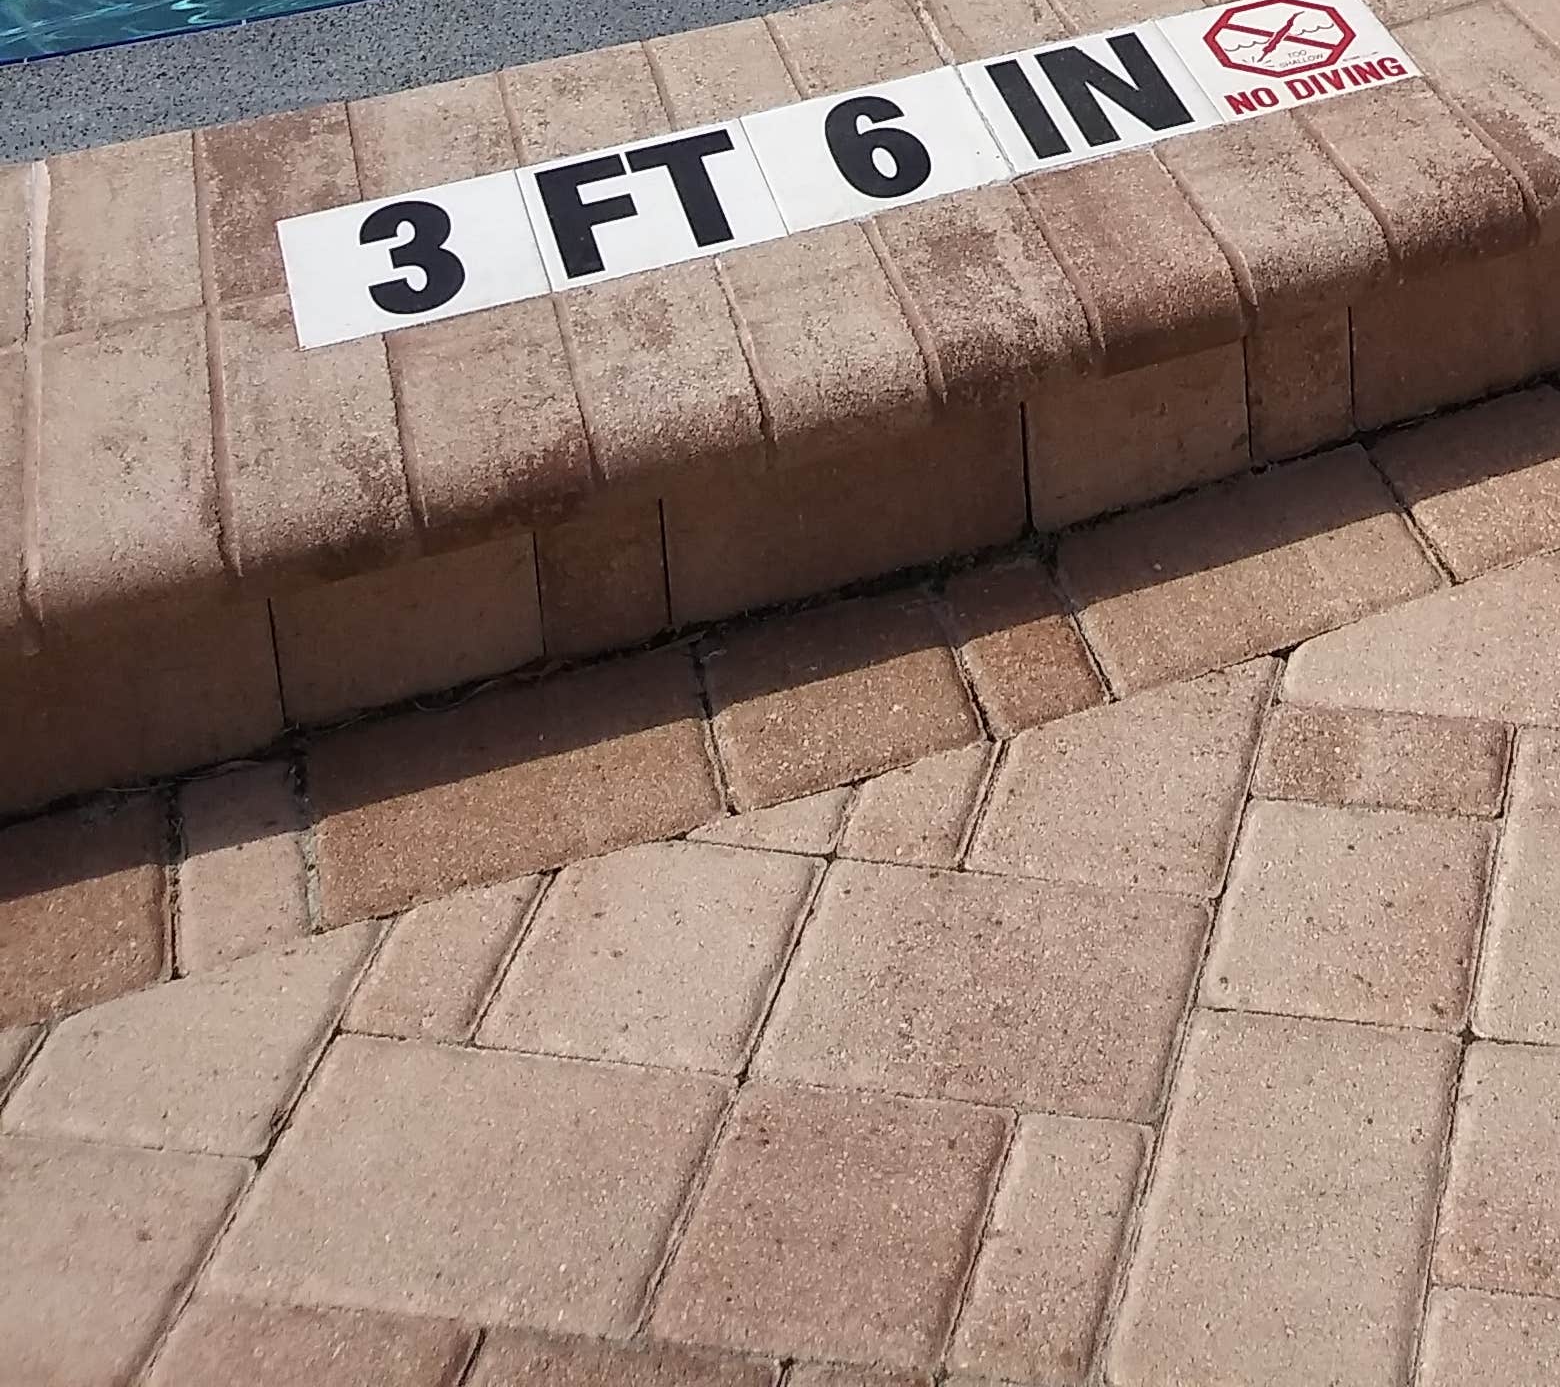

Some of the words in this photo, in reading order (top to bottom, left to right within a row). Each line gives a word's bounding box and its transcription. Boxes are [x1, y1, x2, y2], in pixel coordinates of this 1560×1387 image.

[1279, 52, 1324, 68] SHALLOW
[1287, 49, 1308, 59] TOO
[1223, 87, 1280, 115] NO
[1284, 57, 1409, 101] DIVING
[359, 200, 466, 315] 3
[534, 128, 735, 279] FT
[824, 95, 932, 199] 6
[983, 32, 1196, 160] IN
